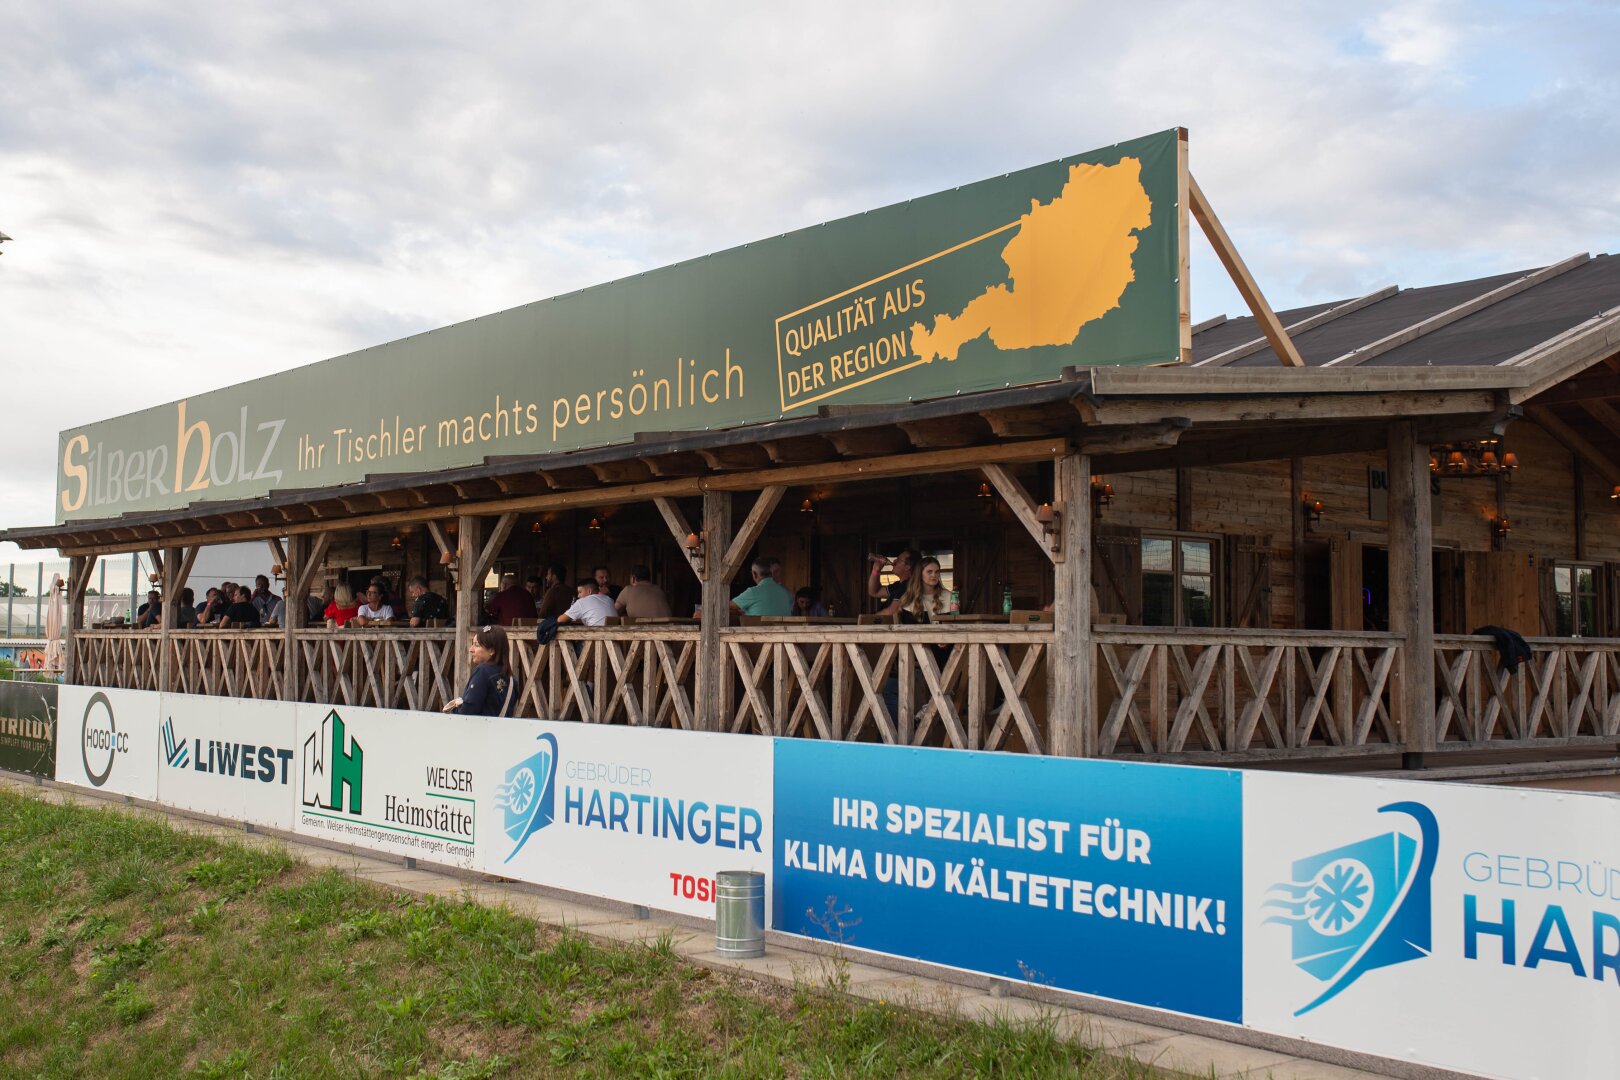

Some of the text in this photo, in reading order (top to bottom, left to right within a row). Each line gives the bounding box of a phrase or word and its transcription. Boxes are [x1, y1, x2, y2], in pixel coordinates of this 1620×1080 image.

[785, 278, 926, 357] QUALITÄT AUS
[787, 331, 907, 398] DER REGION
[298, 347, 744, 472] Ihr Tischler machts persönlich
[194, 738, 294, 785] LIWEST
[426, 766, 473, 793] WELSER
[565, 760, 652, 788] GEBRÜDER
[326, 819, 345, 833] Welser
[385, 795, 472, 836] Heimstätte
[564, 785, 763, 853] HARTINGER
[833, 797, 1152, 865] IHR SPEZIALIST FÜR
[784, 839, 1227, 936] KLIMA UND KÄLTETECHNIK!
